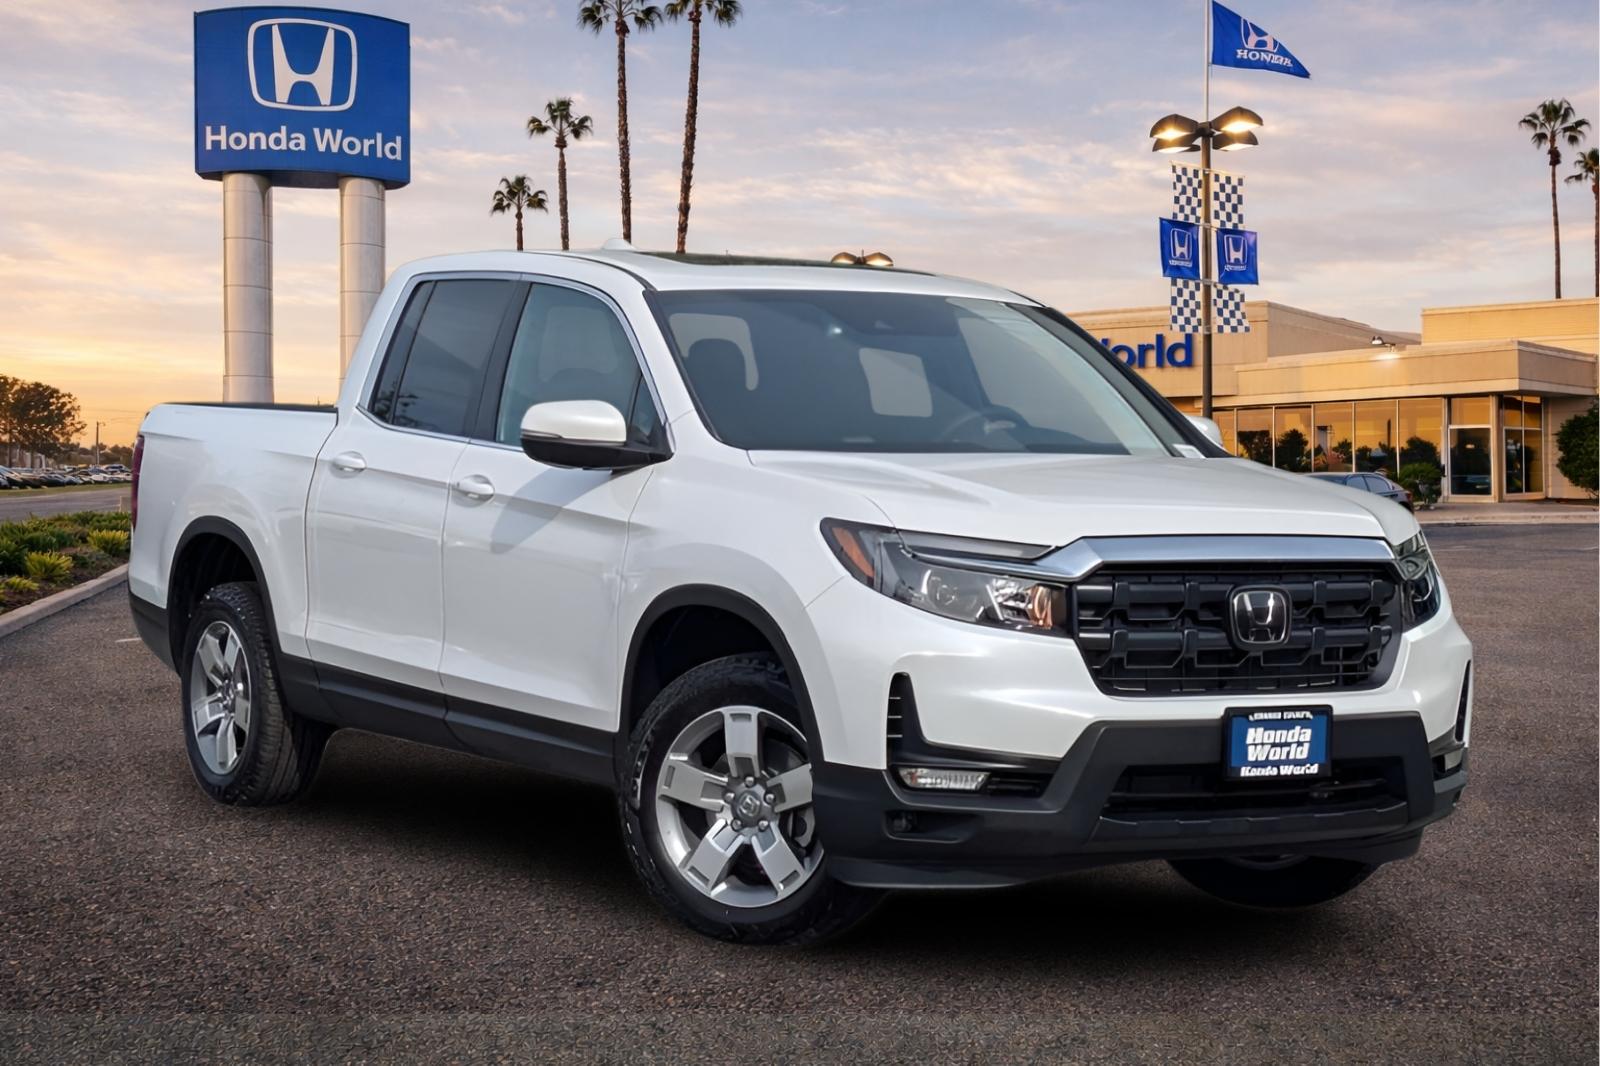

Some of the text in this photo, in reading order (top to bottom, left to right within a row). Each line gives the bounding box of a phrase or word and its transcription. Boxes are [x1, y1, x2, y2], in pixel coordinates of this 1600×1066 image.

[205, 125, 402, 161] Honda World
[1101, 333, 1194, 369] orld
[1246, 725, 1312, 745] Honda
[1247, 742, 1310, 762] World
